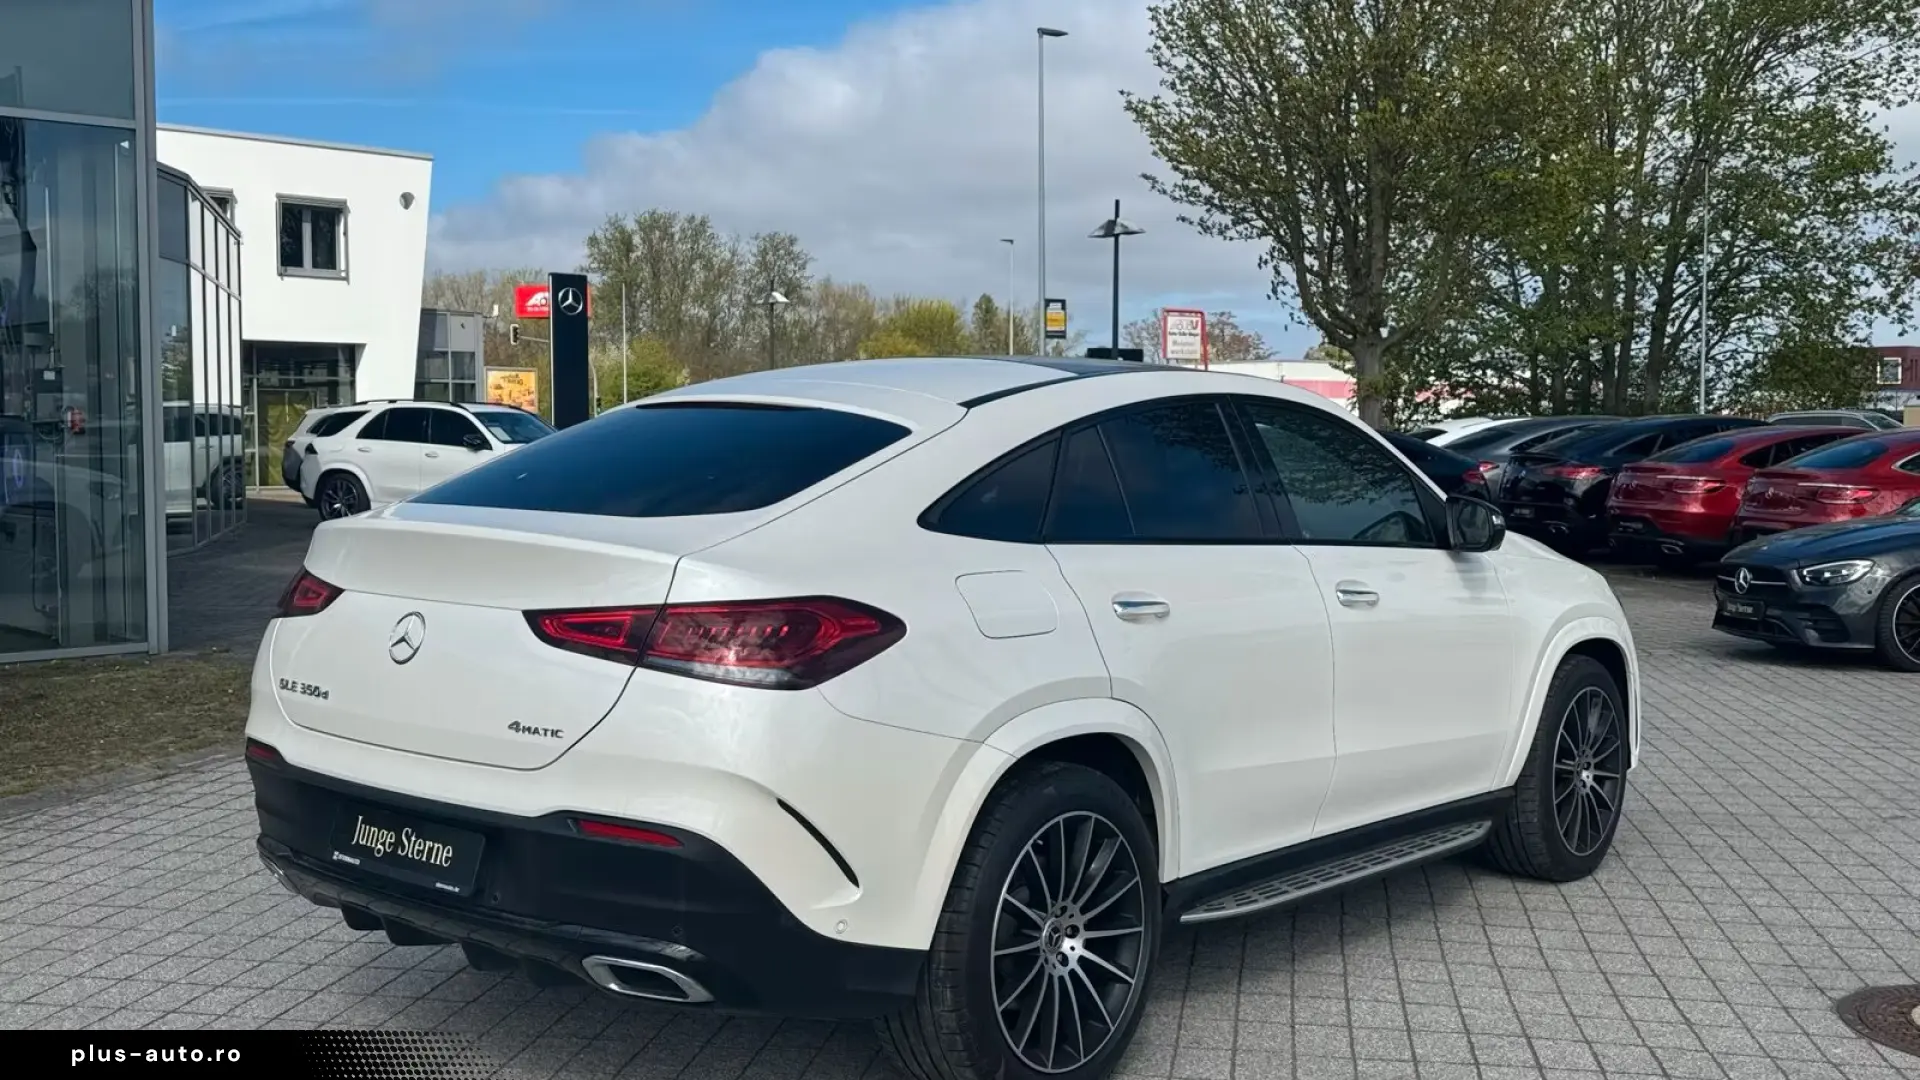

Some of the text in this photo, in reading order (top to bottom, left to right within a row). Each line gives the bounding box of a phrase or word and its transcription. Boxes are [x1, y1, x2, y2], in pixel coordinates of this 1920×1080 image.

[280, 678, 298, 693] GLE
[507, 720, 564, 739] 4MATIC
[351, 815, 453, 867] Junge Sterne
